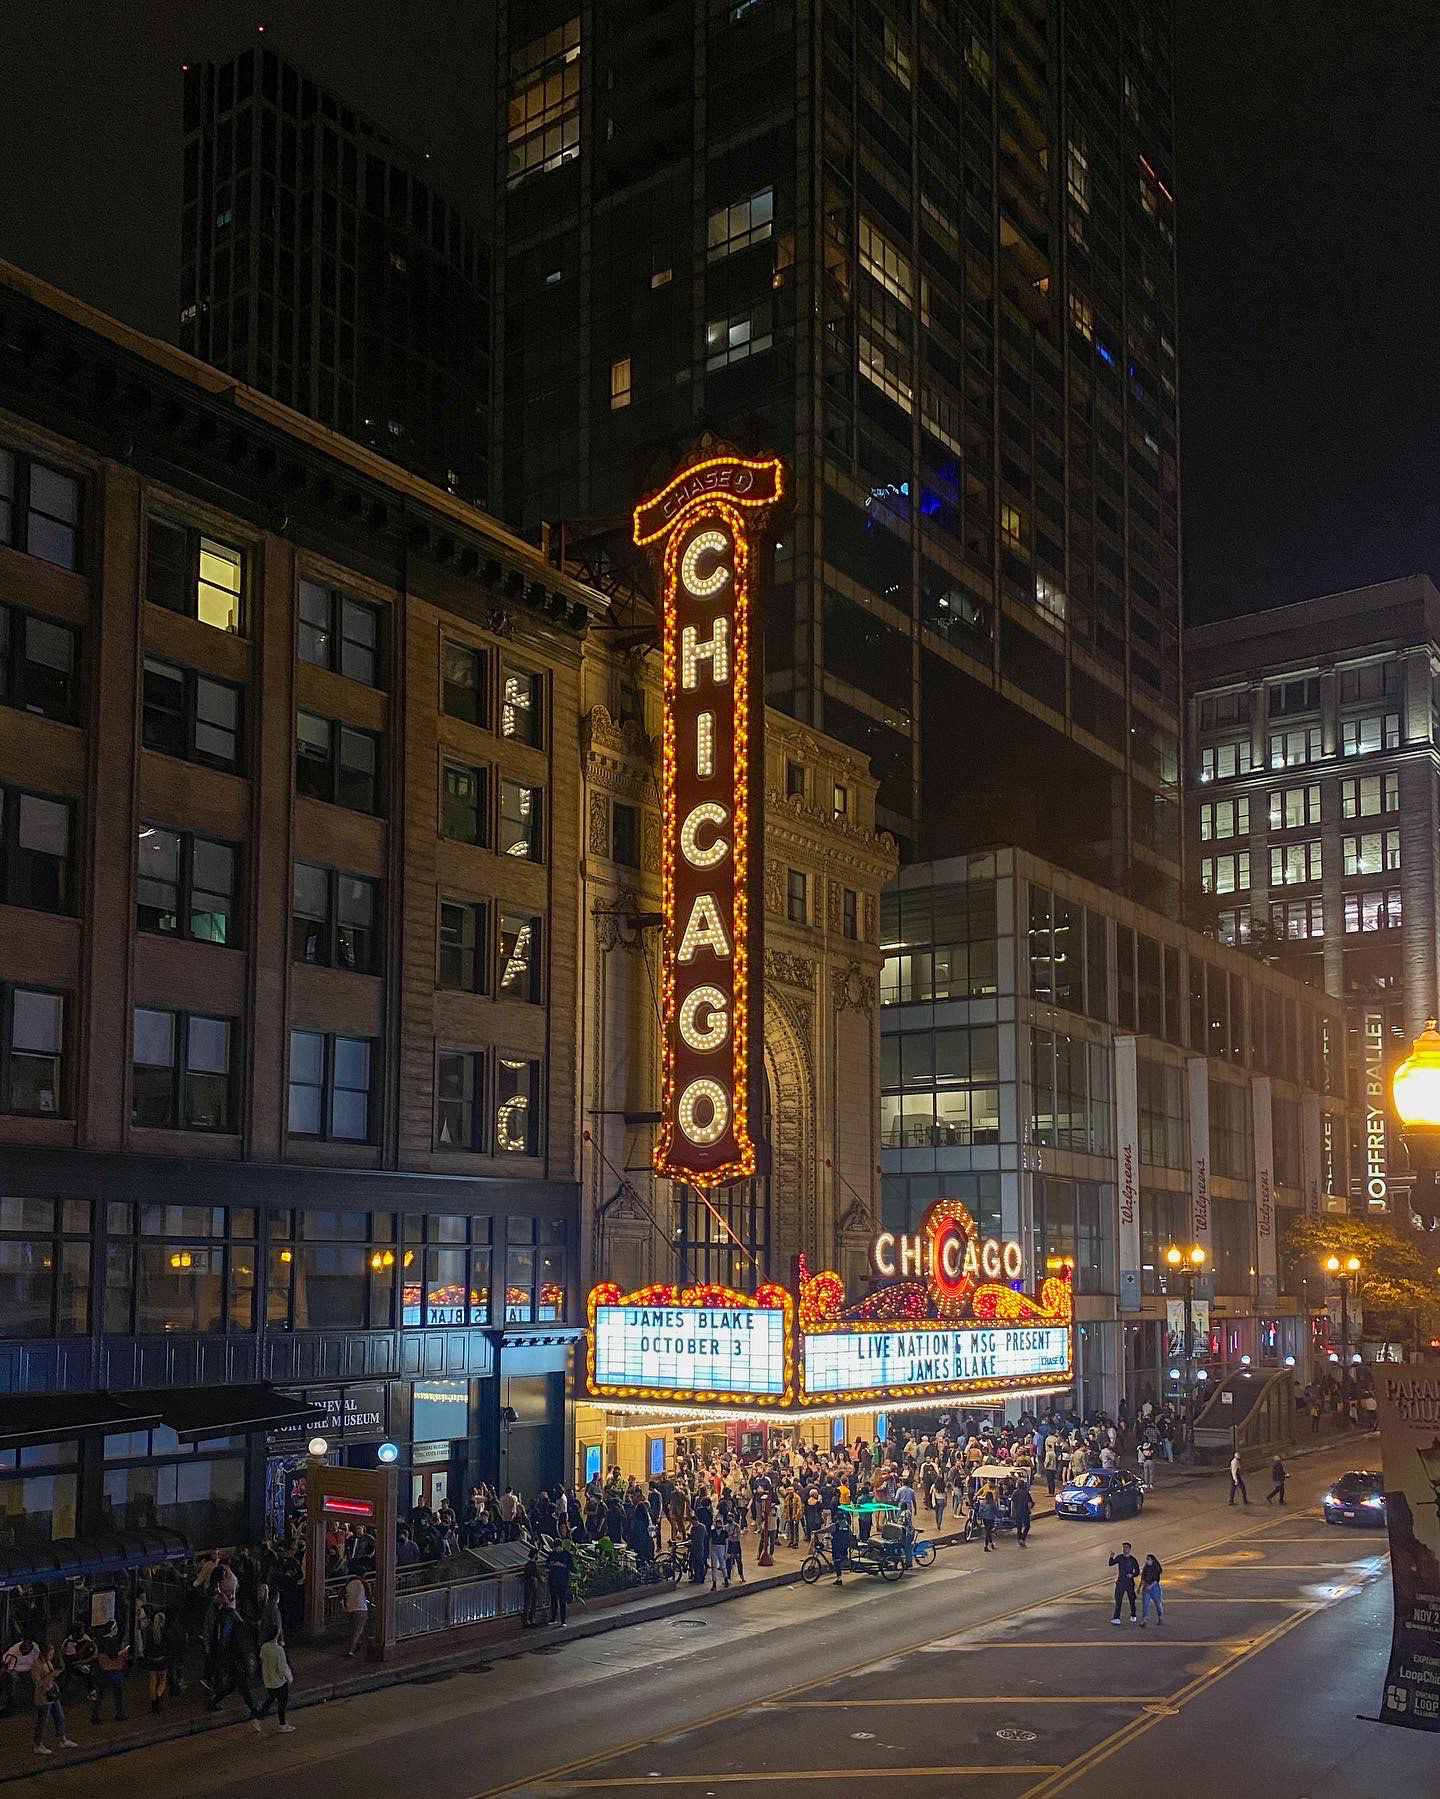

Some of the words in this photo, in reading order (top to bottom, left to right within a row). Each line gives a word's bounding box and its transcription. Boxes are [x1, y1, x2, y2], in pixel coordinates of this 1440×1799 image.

[664, 470, 732, 519] CHASE
[678, 531, 730, 1143] CHICAGO
[1365, 1013, 1384, 1096] BALLET
[1367, 1104, 1386, 1210] JOFFREY
[1122, 1144, 1138, 1225] Walgreens
[1196, 1157, 1211, 1231] Walgreens
[1260, 1169, 1275, 1238] Walgreens
[875, 1233, 1022, 1278] CHICAGO
[630, 1311, 684, 1328] JAMES
[698, 1312, 755, 1330] BLAKE
[641, 1337, 720, 1355] OCTOBER
[734, 1340, 742, 1355] 3
[857, 1336, 890, 1359] LIVE
[897, 1333, 949, 1357] NATION
[954, 1334, 962, 1355] &
[971, 1332, 996, 1353] MSG
[1005, 1330, 1051, 1351] PRESENT
[1041, 1357, 1059, 1366] CHASE
[907, 1358, 950, 1382] JAMES
[955, 1355, 997, 1378] BLAKE
[331, 1413, 380, 1427] MUSEUM
[1414, 1608, 1432, 1624] NOV
[1414, 1698, 1439, 1712] LOOP
